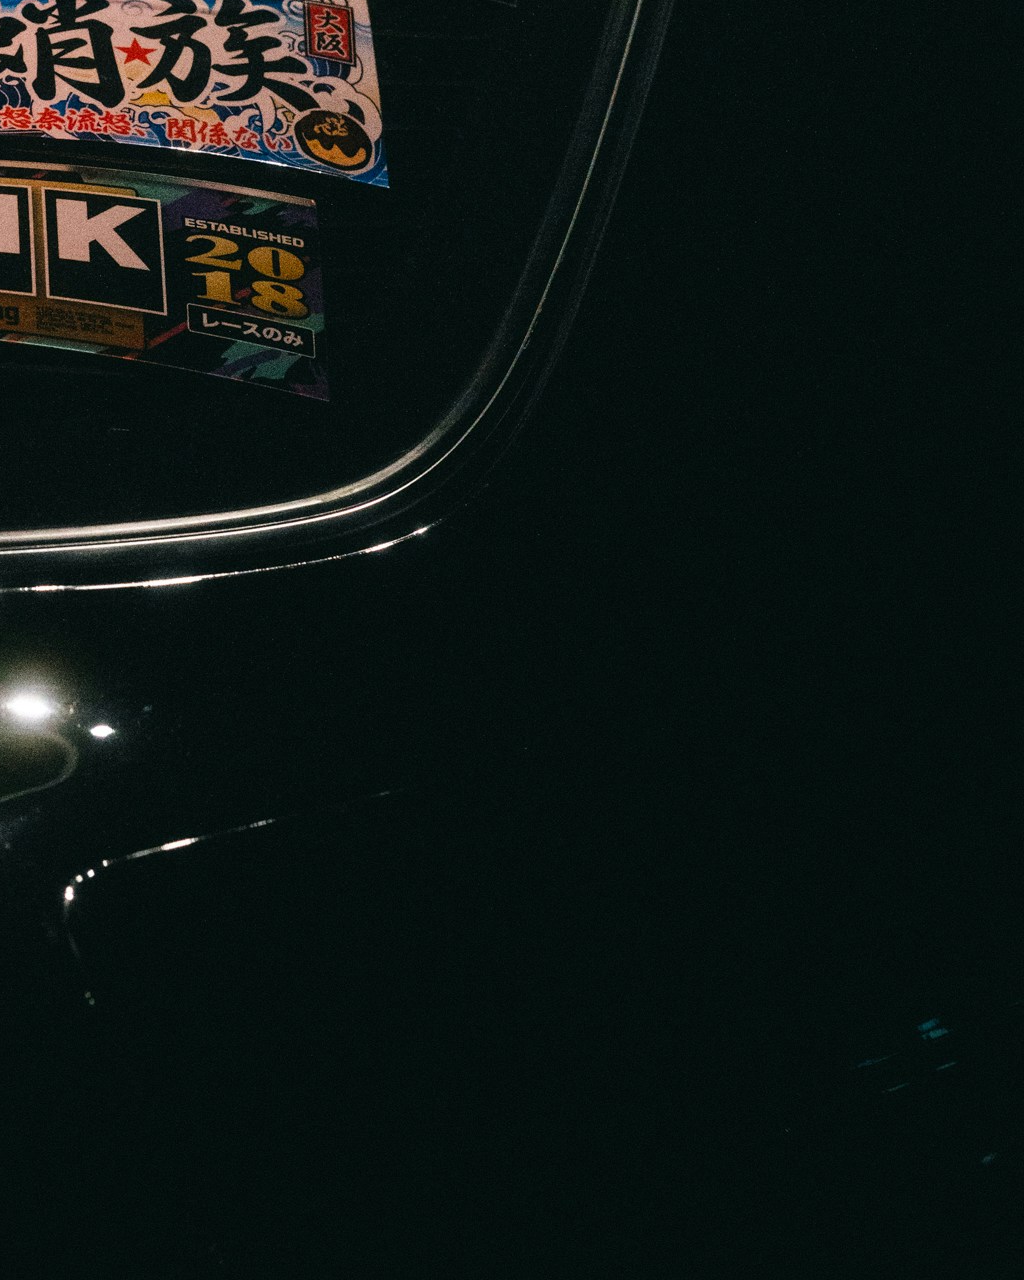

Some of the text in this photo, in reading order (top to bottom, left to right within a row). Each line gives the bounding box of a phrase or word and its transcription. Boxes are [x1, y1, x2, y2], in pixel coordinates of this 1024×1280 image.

[312, 8, 347, 59] 大阪
[184, 217, 304, 249] ESTABLISHED
[202, 312, 304, 347] レースのみ
